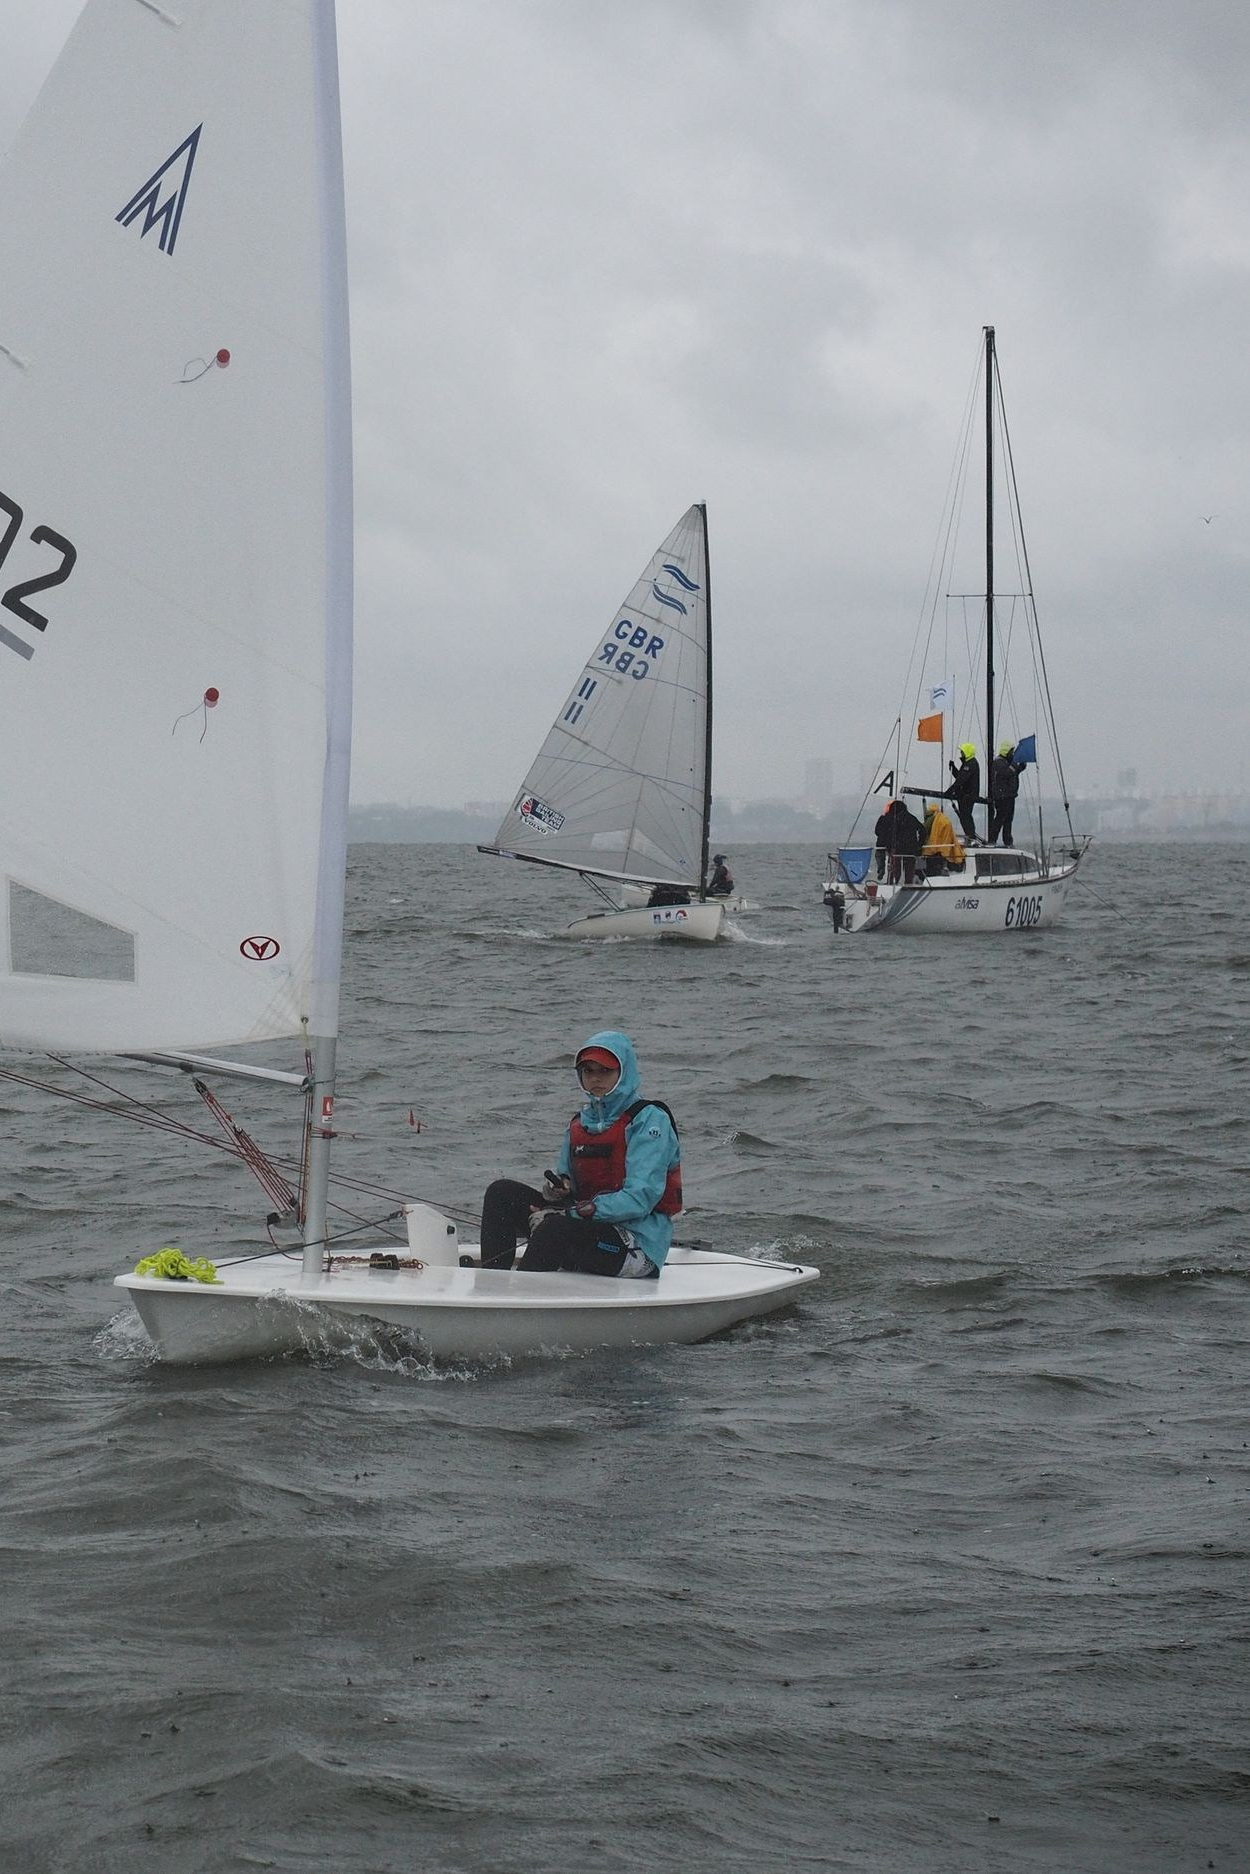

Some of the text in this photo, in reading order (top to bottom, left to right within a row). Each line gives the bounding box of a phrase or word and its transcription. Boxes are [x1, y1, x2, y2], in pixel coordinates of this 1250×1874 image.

[614, 619, 664, 659] GBR
[578, 677, 598, 701] 11
[873, 770, 894, 797] A
[535, 806, 562, 825] SAILING
[537, 803, 564, 821] BRITISH
[540, 815, 559, 829] TEAM
[523, 818, 546, 834] VOLVO
[1005, 895, 1043, 927] 61005
